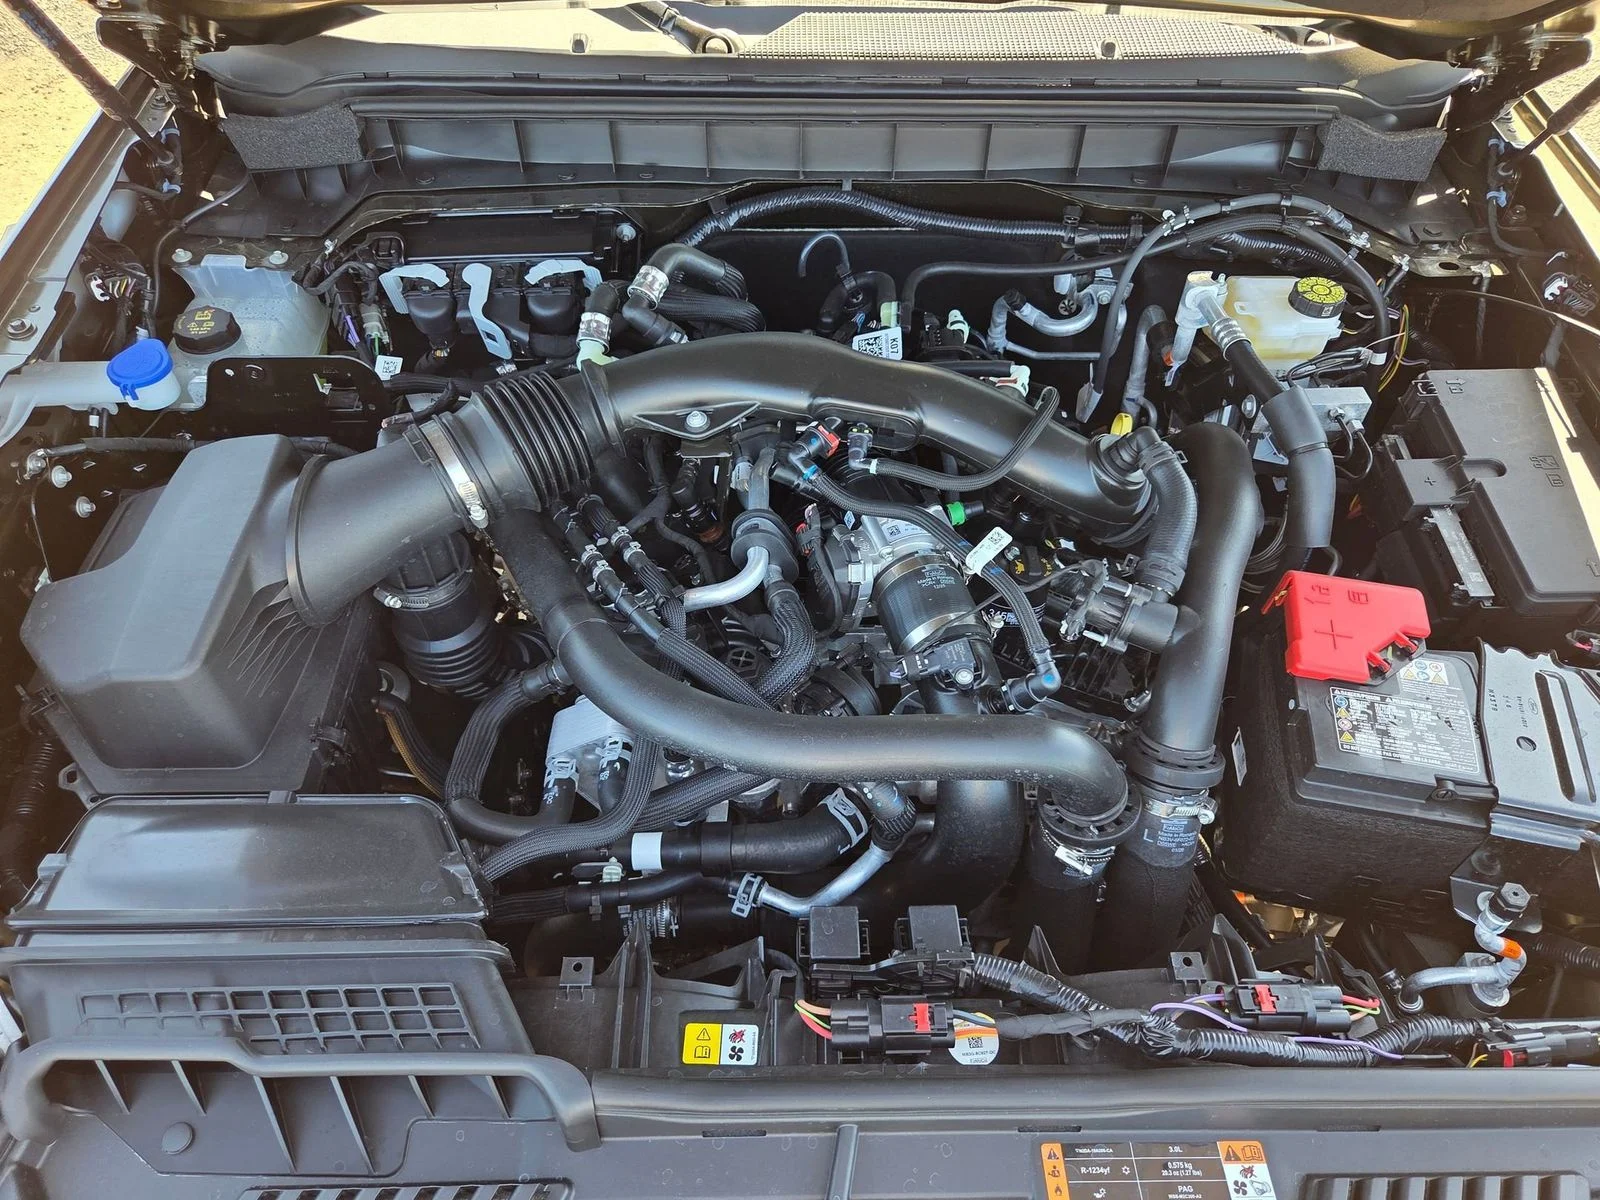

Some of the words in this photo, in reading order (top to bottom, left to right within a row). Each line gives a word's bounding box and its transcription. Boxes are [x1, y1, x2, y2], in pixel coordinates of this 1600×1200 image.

[890, 337, 899, 354] K07
[1184, 1161, 1193, 1170] kg
[1080, 1166, 1111, 1175] R-1234yf
